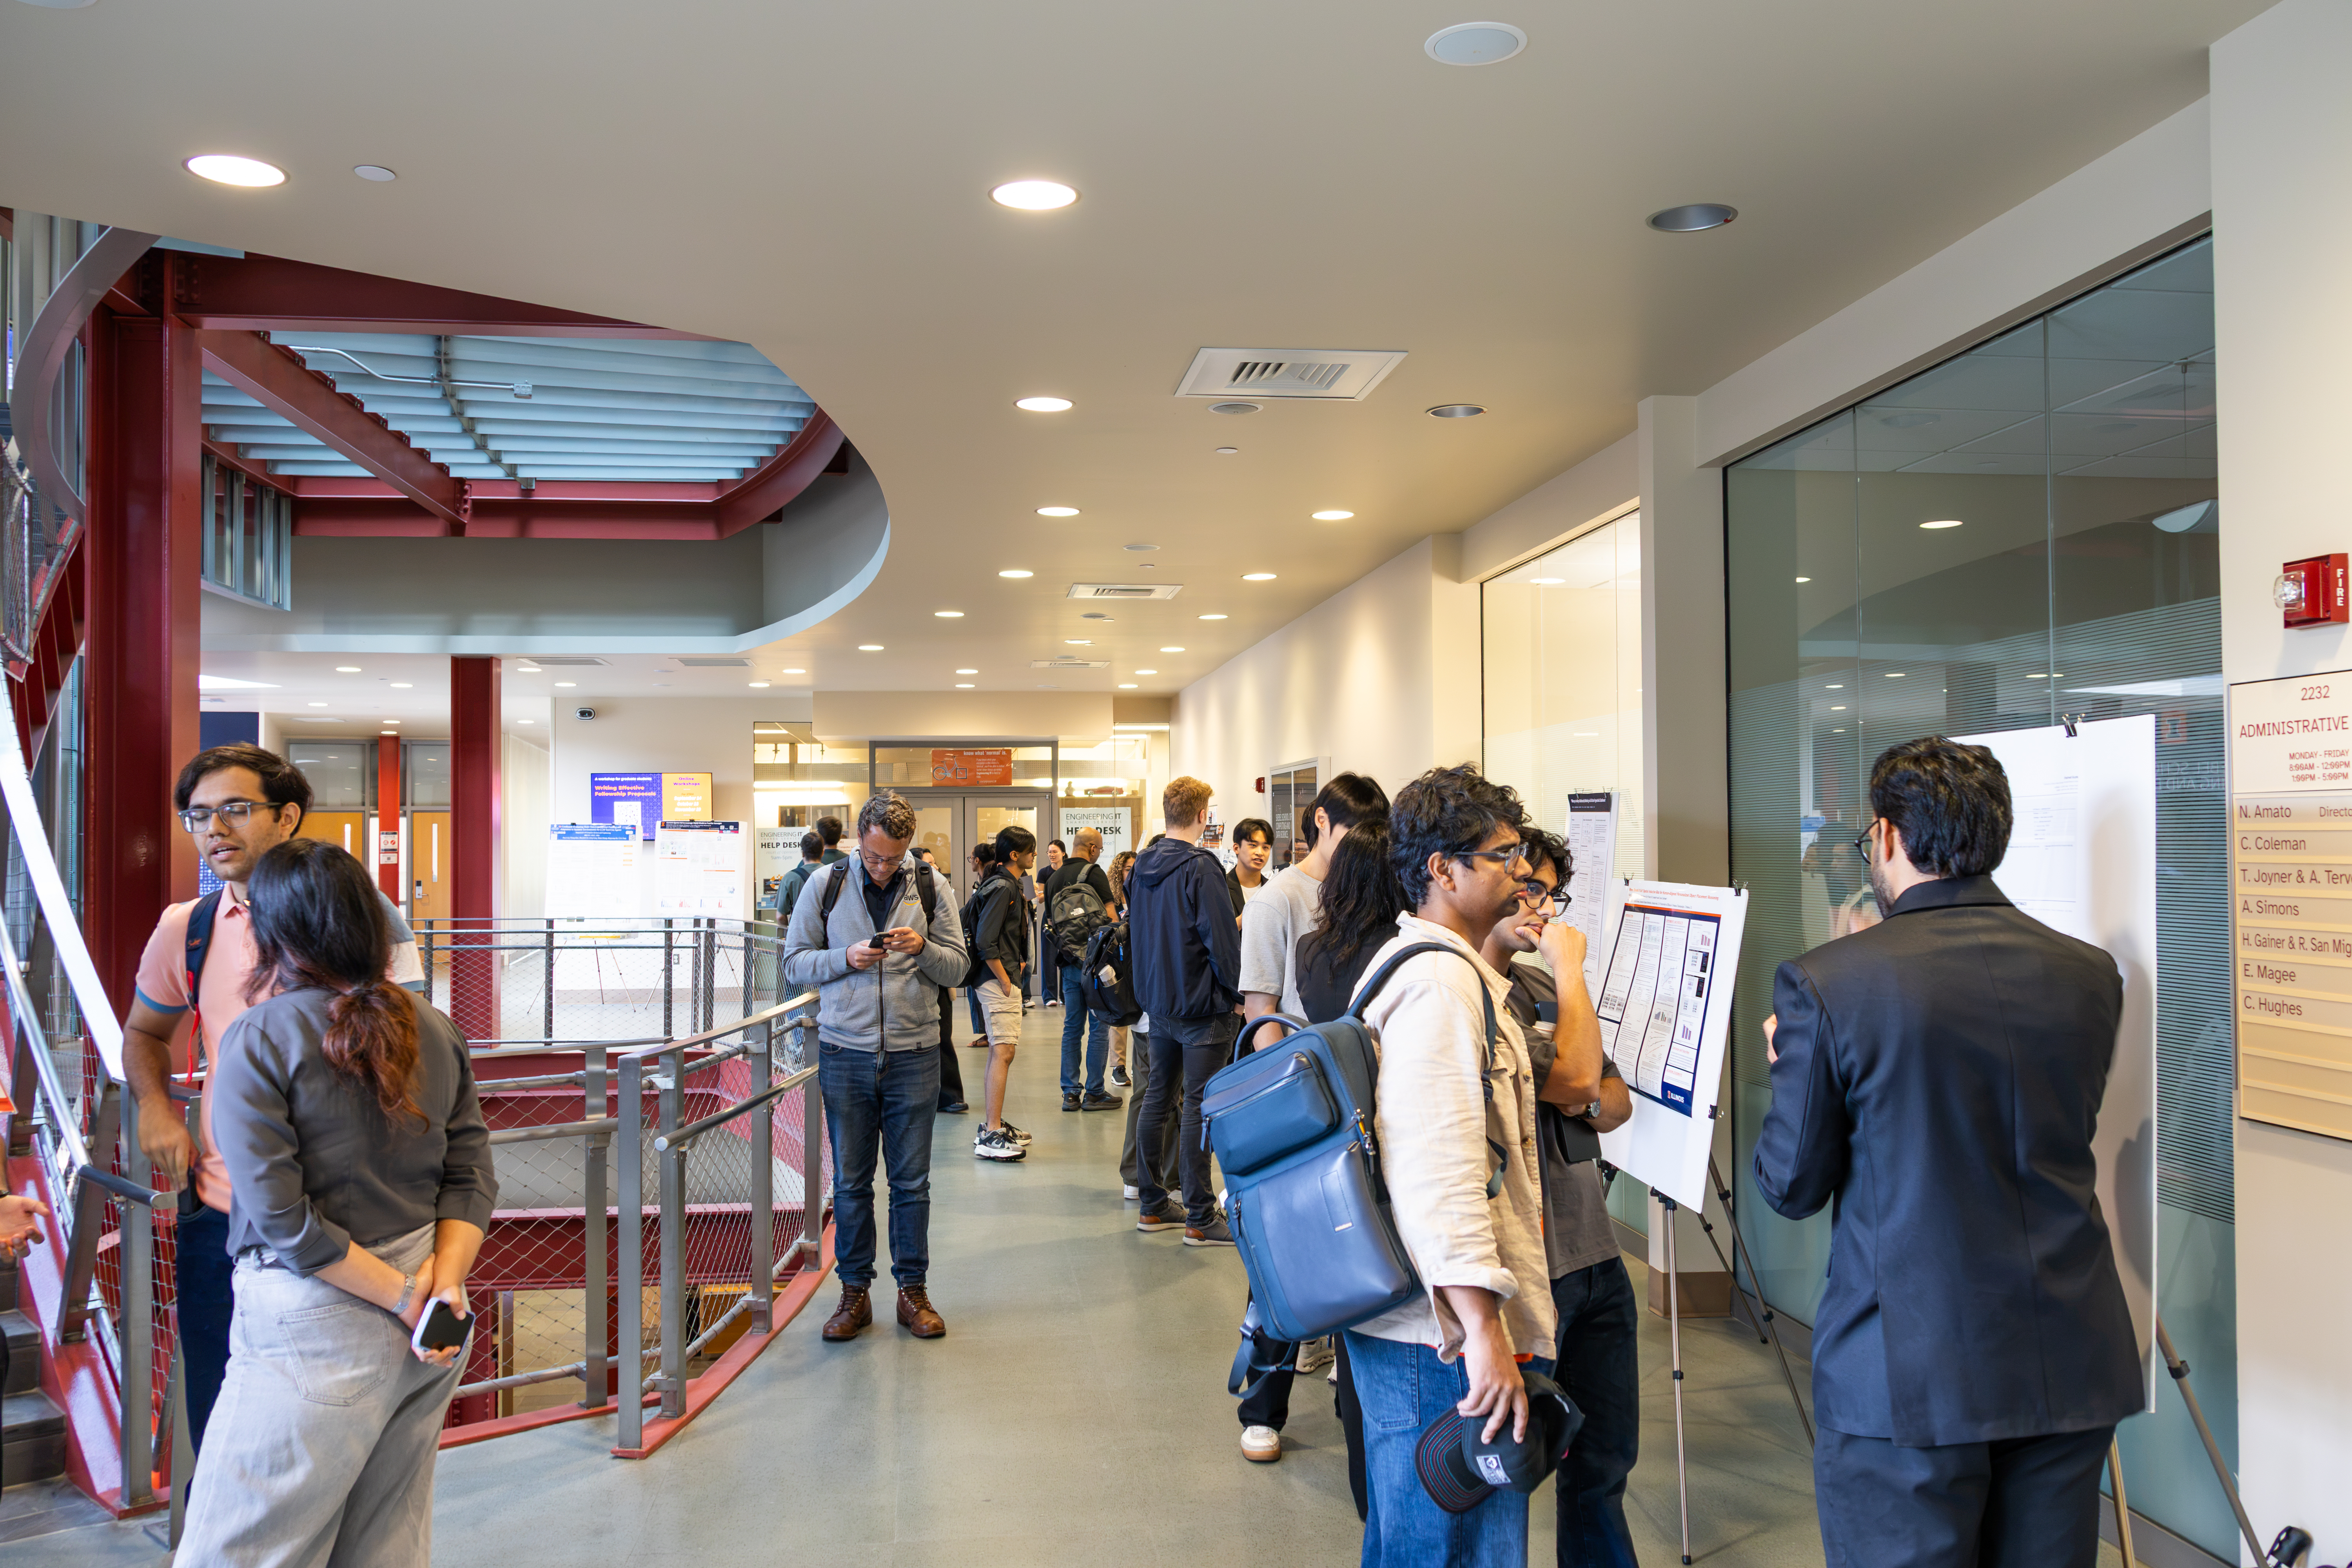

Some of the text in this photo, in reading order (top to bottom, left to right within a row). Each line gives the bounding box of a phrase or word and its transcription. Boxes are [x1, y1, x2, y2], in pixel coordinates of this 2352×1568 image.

[2301, 685, 2330, 701] 2232
[2239, 716, 2349, 738] ADMINISTRATIVE
[2289, 751, 2318, 760] MONDAY
[2324, 749, 2349, 758] FRIDAY
[2289, 763, 2315, 771] 8:00AM
[2321, 761, 2350, 770] 12:00PM
[2322, 772, 2348, 781] 5:00PM
[2239, 805, 2250, 818] N.
[2254, 805, 2291, 818] Amato
[2241, 837, 2306, 850] C. Coleman
[2241, 869, 2352, 886] T. Joyner & A. Terv
[2242, 900, 2299, 916] A. Simons
[2243, 933, 2352, 957] H. Gainer & R. San Mig
[2244, 964, 2296, 984] E. Magee
[2244, 995, 2303, 1016] C. Hughes
[1671, 1093, 1684, 1103] ILLINOIS
